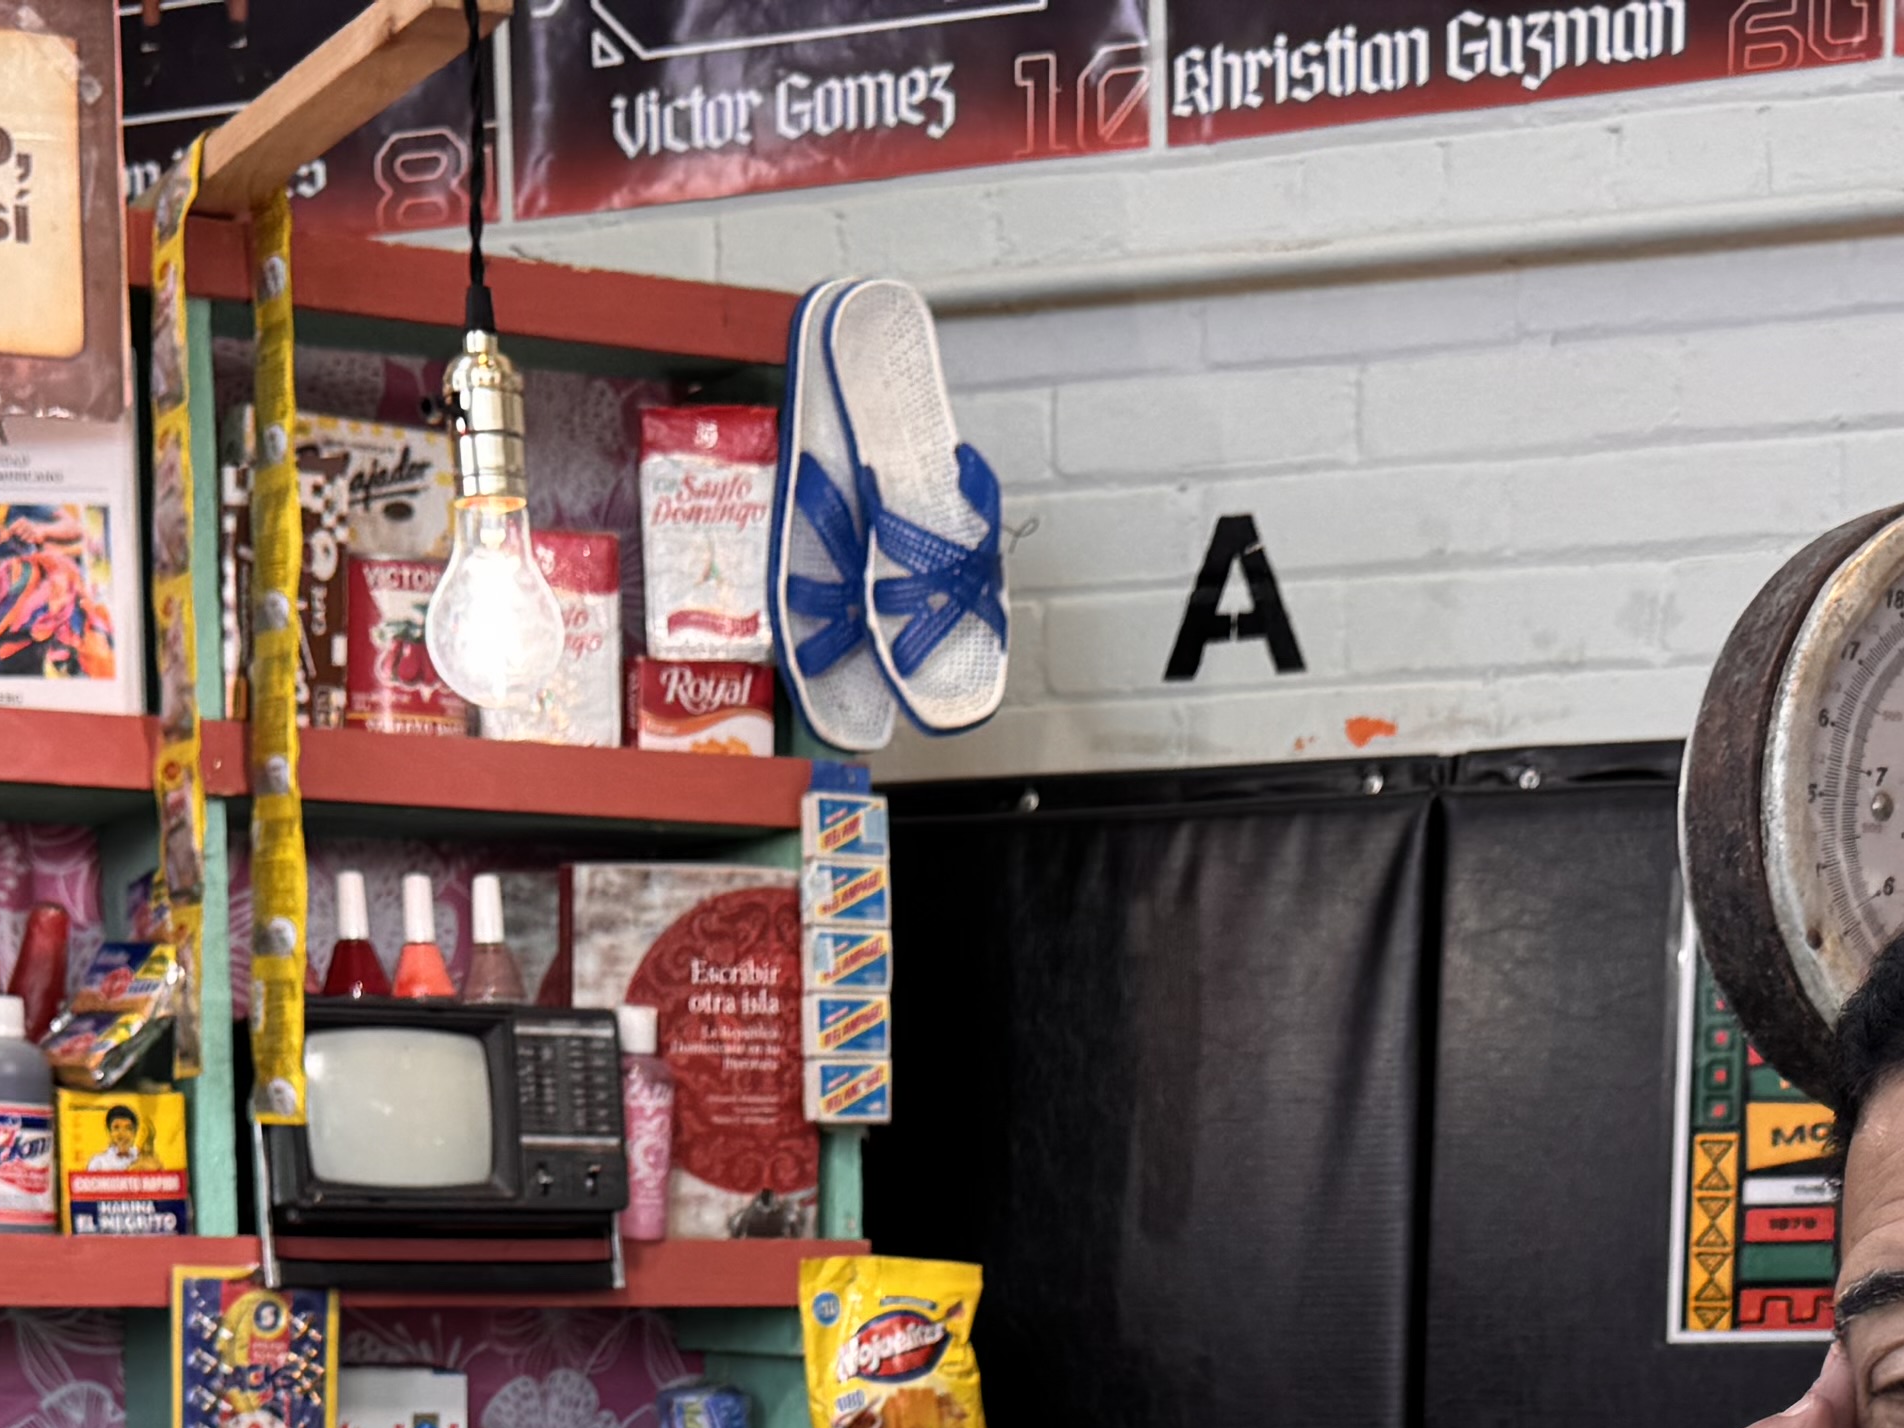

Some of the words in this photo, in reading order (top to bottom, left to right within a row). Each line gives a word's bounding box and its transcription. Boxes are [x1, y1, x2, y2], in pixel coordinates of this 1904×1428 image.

[1447, 0, 1685, 90] Guzman
[613, 88, 763, 160] Victor
[775, 62, 955, 141] Gomez
[676, 471, 753, 503] Santo
[651, 493, 768, 532] Domingo
[1163, 515, 1307, 680] A
[660, 664, 753, 716] Royal
[1876, 766, 1888, 787] 7
[1883, 876, 1895, 896] 6
[690, 957, 781, 985] Escribir
[688, 991, 736, 1015] otra
